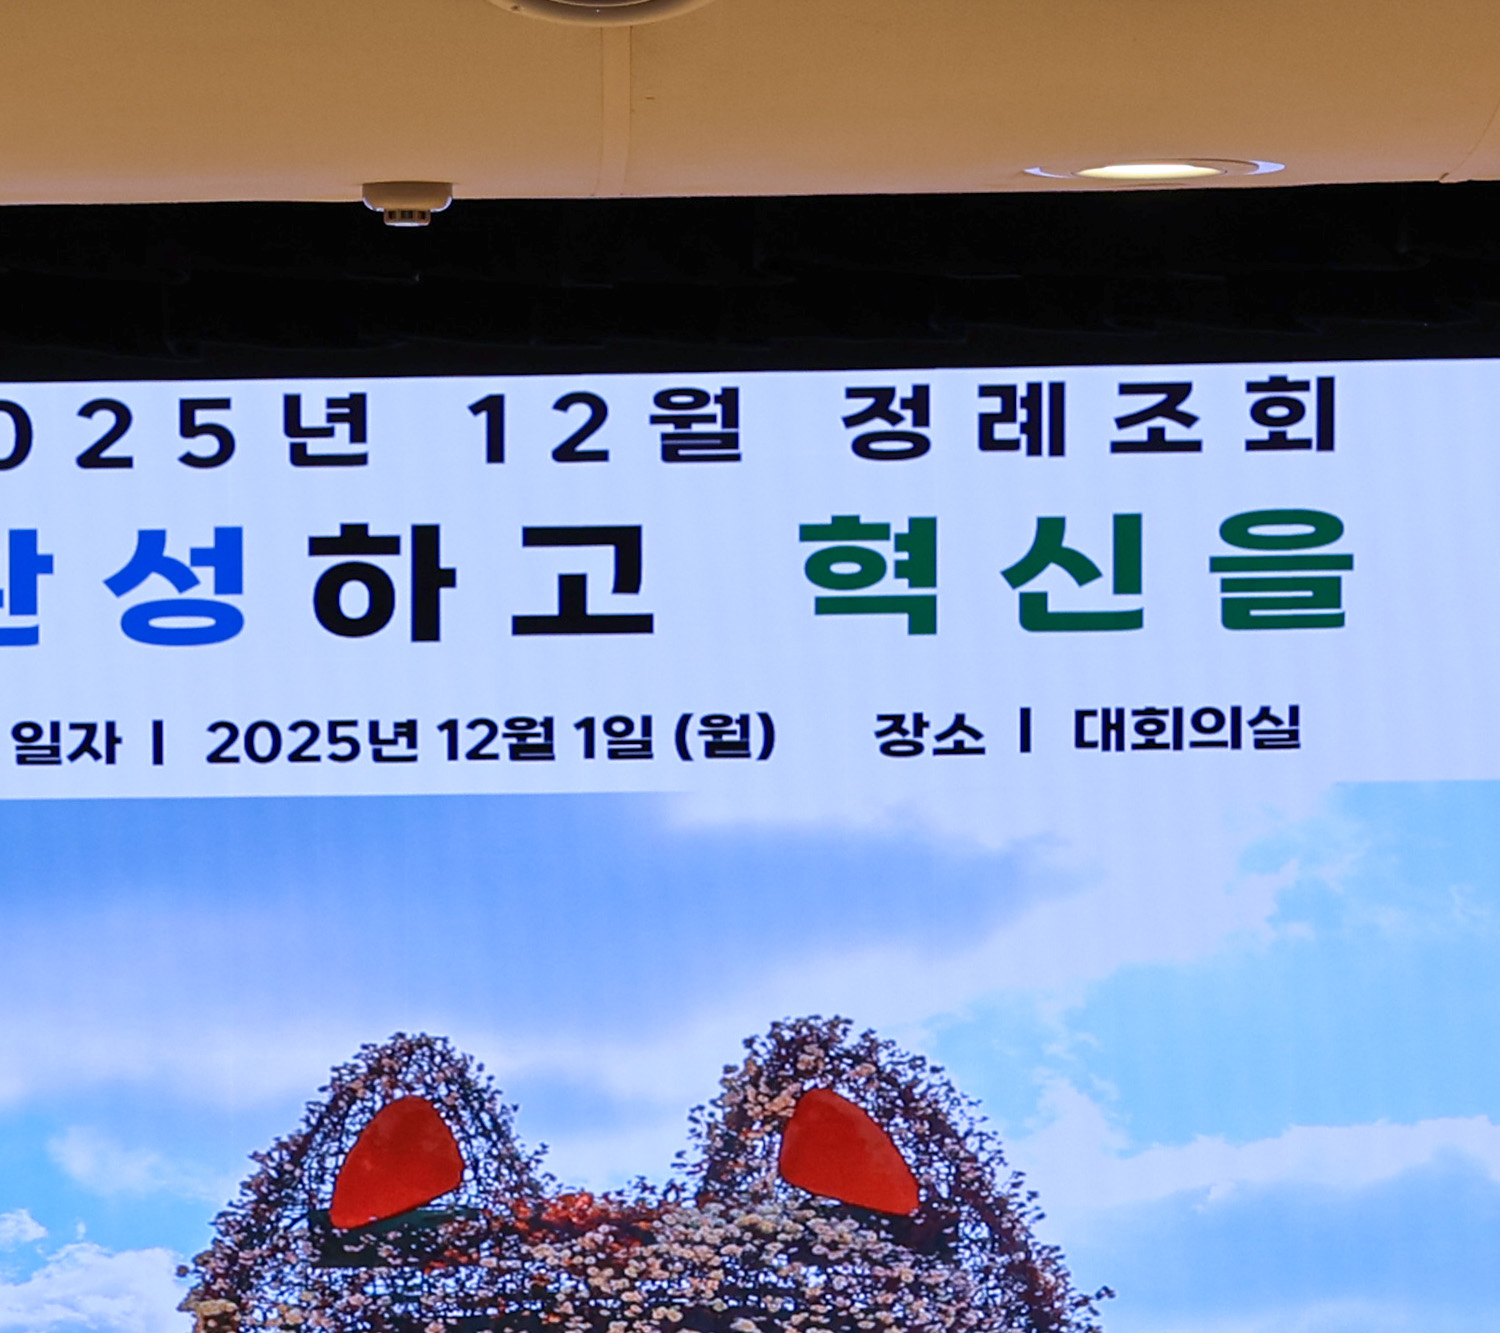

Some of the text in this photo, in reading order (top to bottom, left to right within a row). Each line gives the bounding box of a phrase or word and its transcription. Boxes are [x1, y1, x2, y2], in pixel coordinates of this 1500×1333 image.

[467, 385, 743, 465] 12월
[841, 374, 1336, 462] 정례조회
[798, 507, 1355, 636] 혁신을
[10, 719, 123, 766] 일자
[205, 718, 419, 764] 2025년
[437, 715, 557, 762] 12월
[573, 714, 655, 761] 1일
[673, 711, 777, 762] (월)
[873, 711, 987, 758] 장소
[1072, 703, 1303, 754] 대회의실
